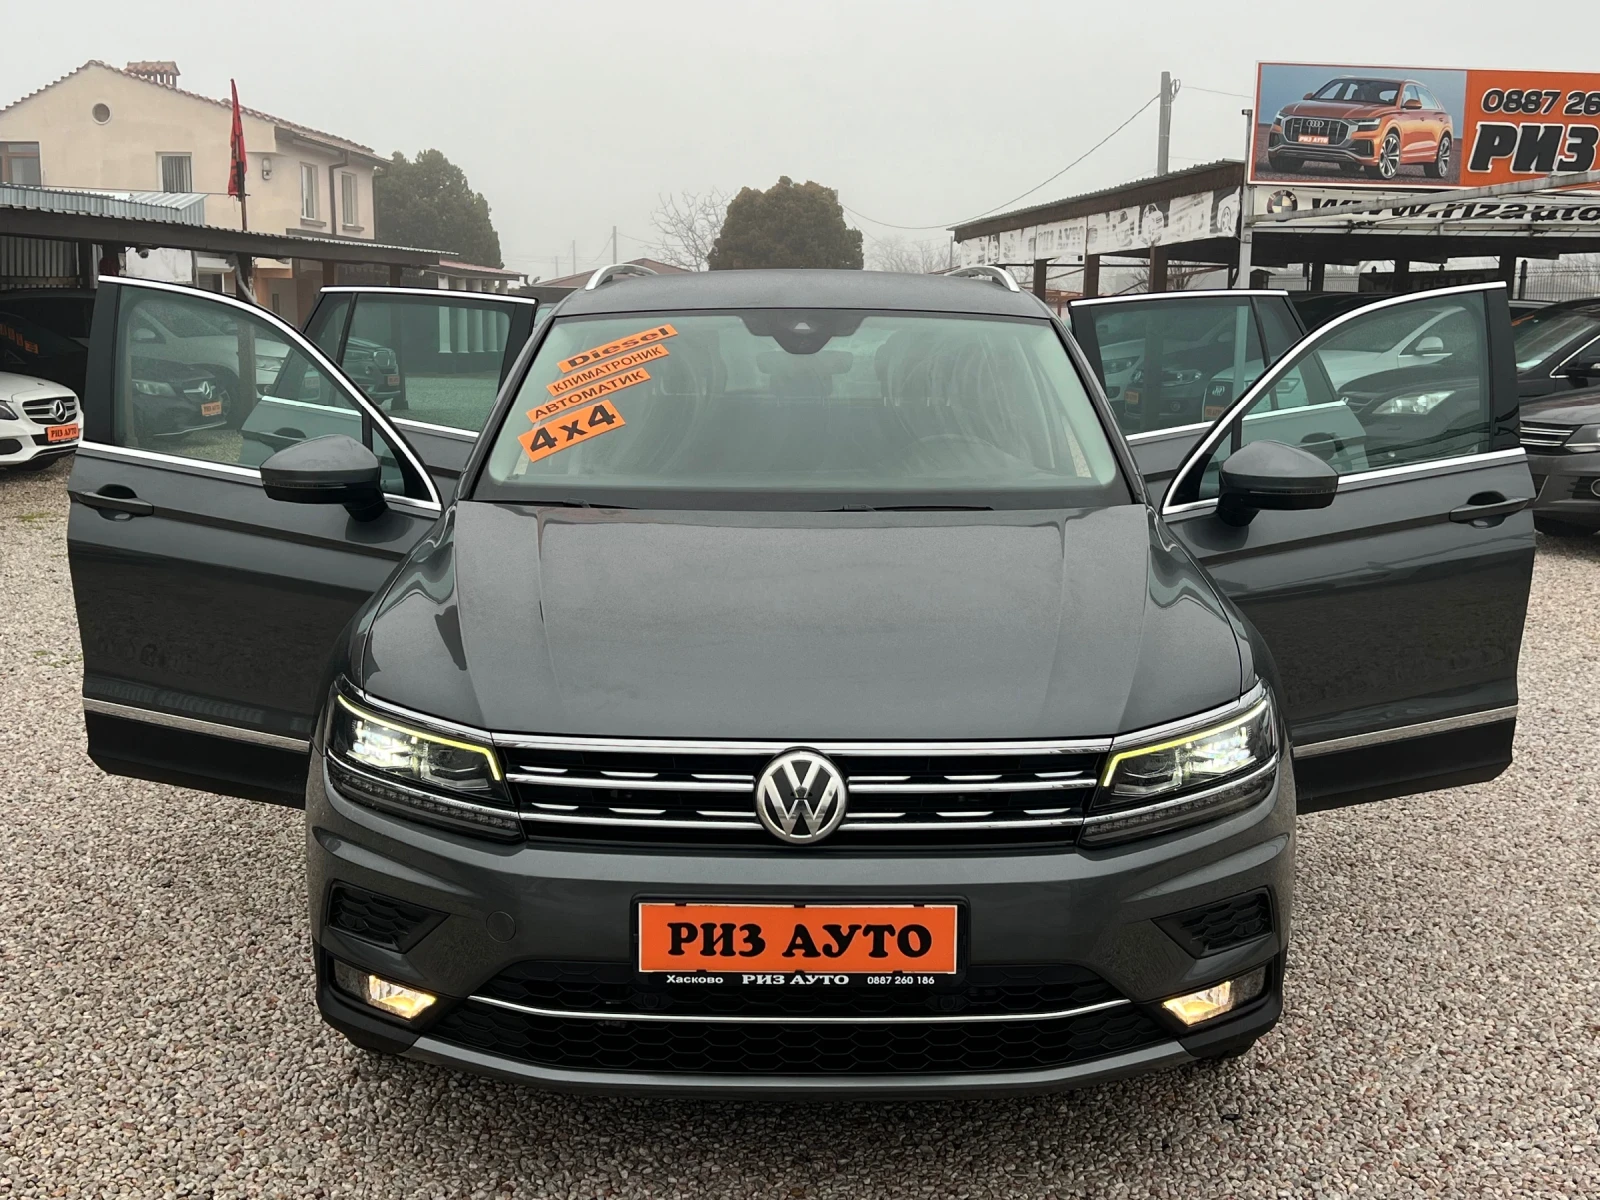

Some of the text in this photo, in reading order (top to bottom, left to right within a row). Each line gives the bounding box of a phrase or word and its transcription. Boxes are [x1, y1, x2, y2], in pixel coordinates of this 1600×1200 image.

[1481, 88, 1600, 116] 0887 26
[1467, 121, 1599, 174] РИЗ
[567, 327, 669, 368] Diesel
[552, 346, 662, 392] КЛИМАТРОНИК
[534, 370, 645, 420] АВТОМАТИК
[666, 922, 932, 958] РИЗ АУТО
[666, 974, 935, 986] Хасково РИЗ АУТО 0887 260 186
